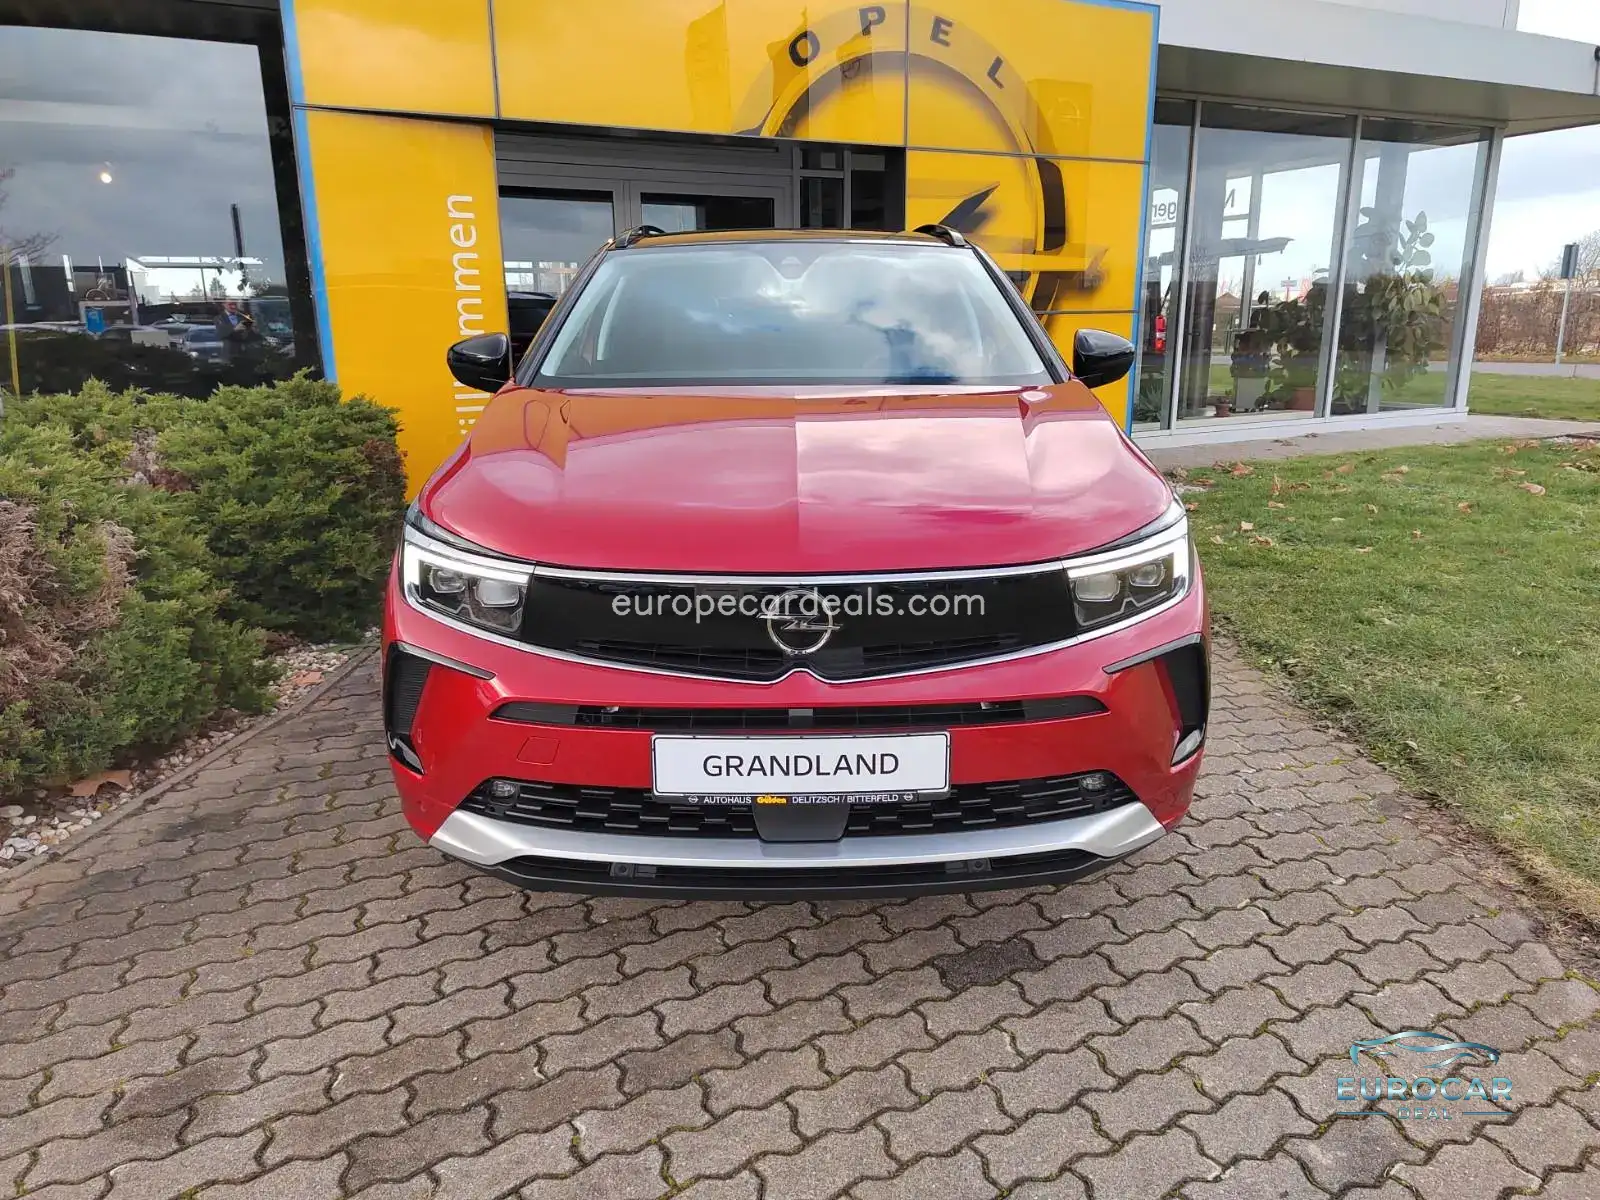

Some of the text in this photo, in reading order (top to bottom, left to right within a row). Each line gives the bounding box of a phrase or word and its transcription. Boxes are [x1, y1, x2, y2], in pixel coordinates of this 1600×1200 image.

[788, 6, 1004, 90] OPEL
[702, 752, 900, 777] GRANDLAND
[703, 796, 752, 804] AUTOHAUS
[792, 795, 839, 805] DELITZSCH
[846, 794, 899, 804] BITTERFELD
